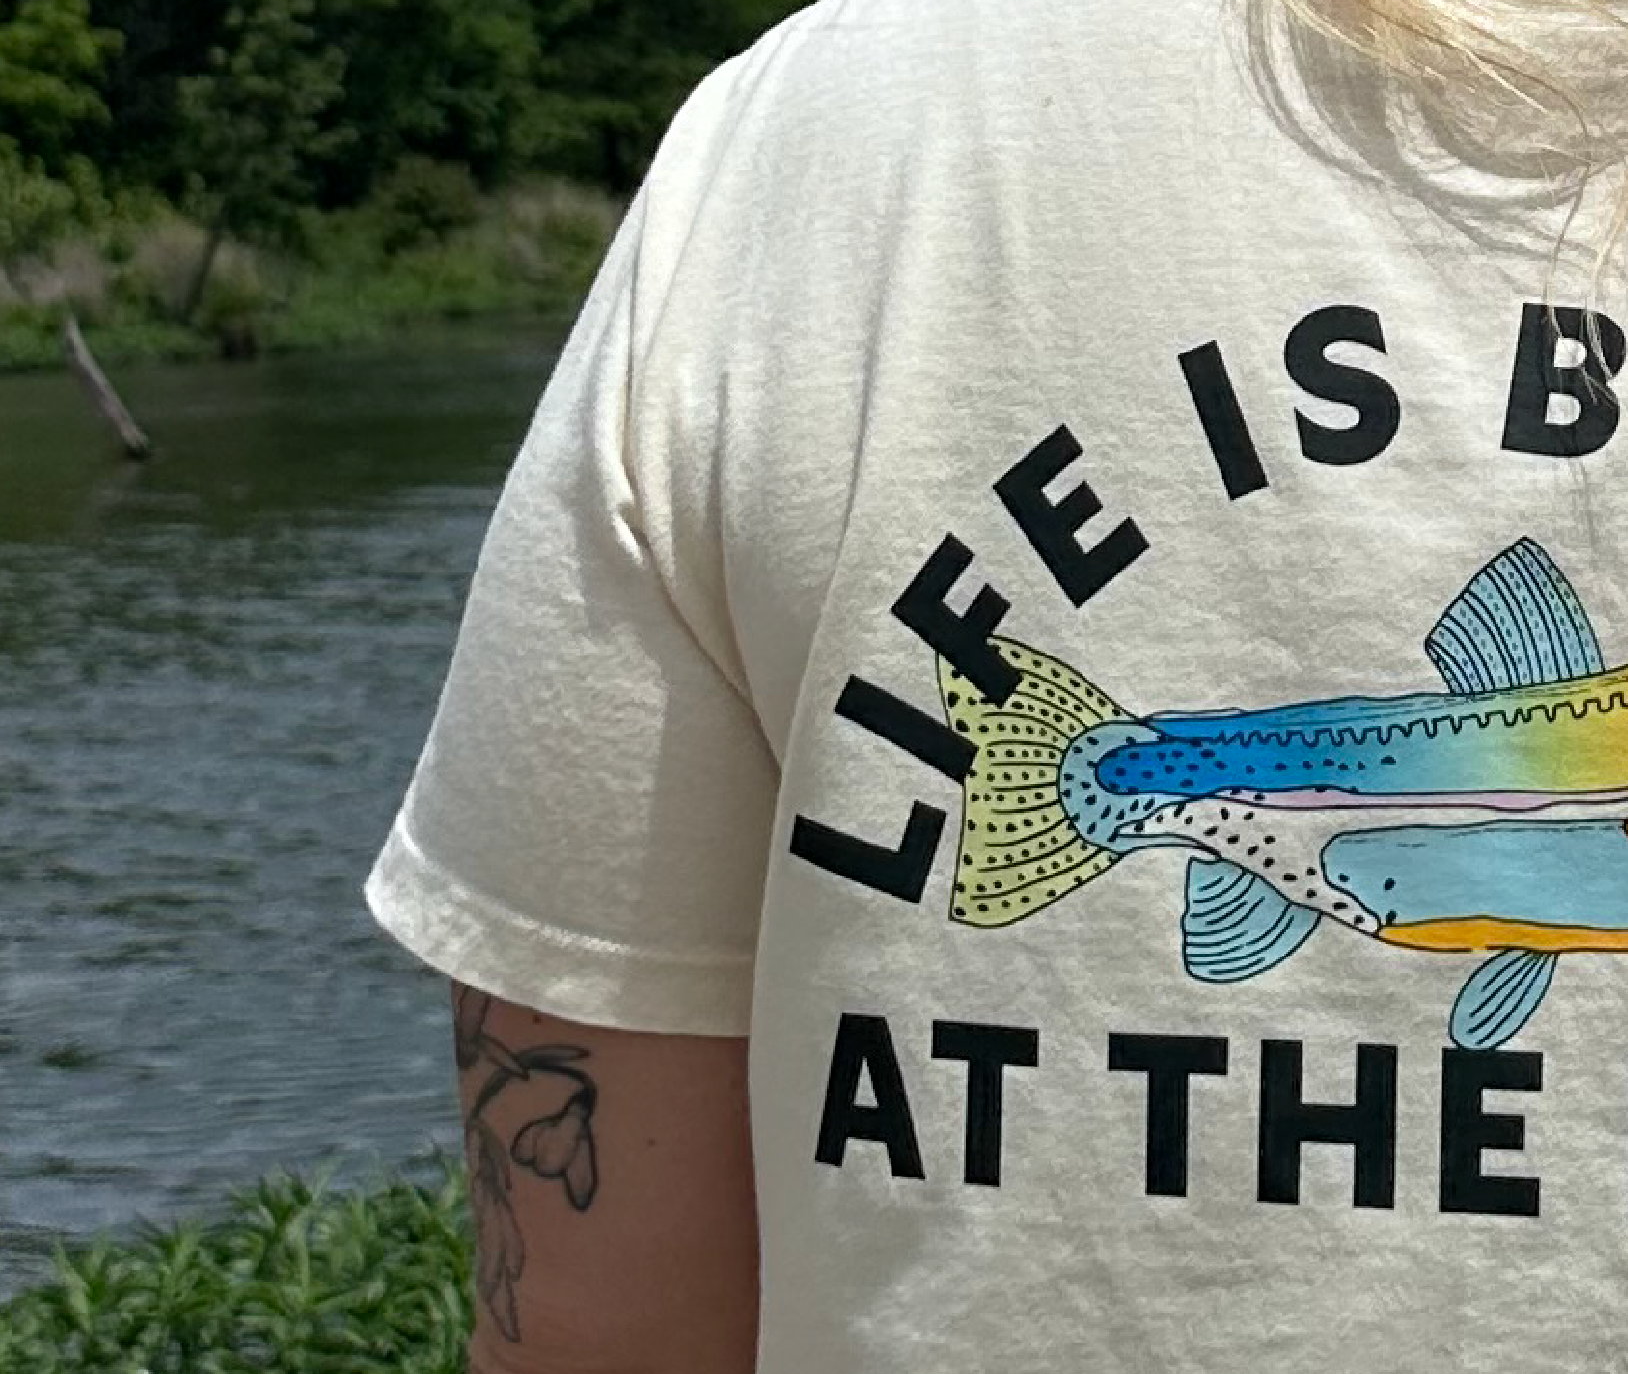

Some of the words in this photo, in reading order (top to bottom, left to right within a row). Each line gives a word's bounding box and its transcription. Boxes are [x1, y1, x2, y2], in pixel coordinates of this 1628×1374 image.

[789, 424, 1150, 905] LIFE
[1177, 303, 1402, 502] IS
[814, 1012, 1040, 1189] AT
[1108, 1032, 1542, 1217] THE
